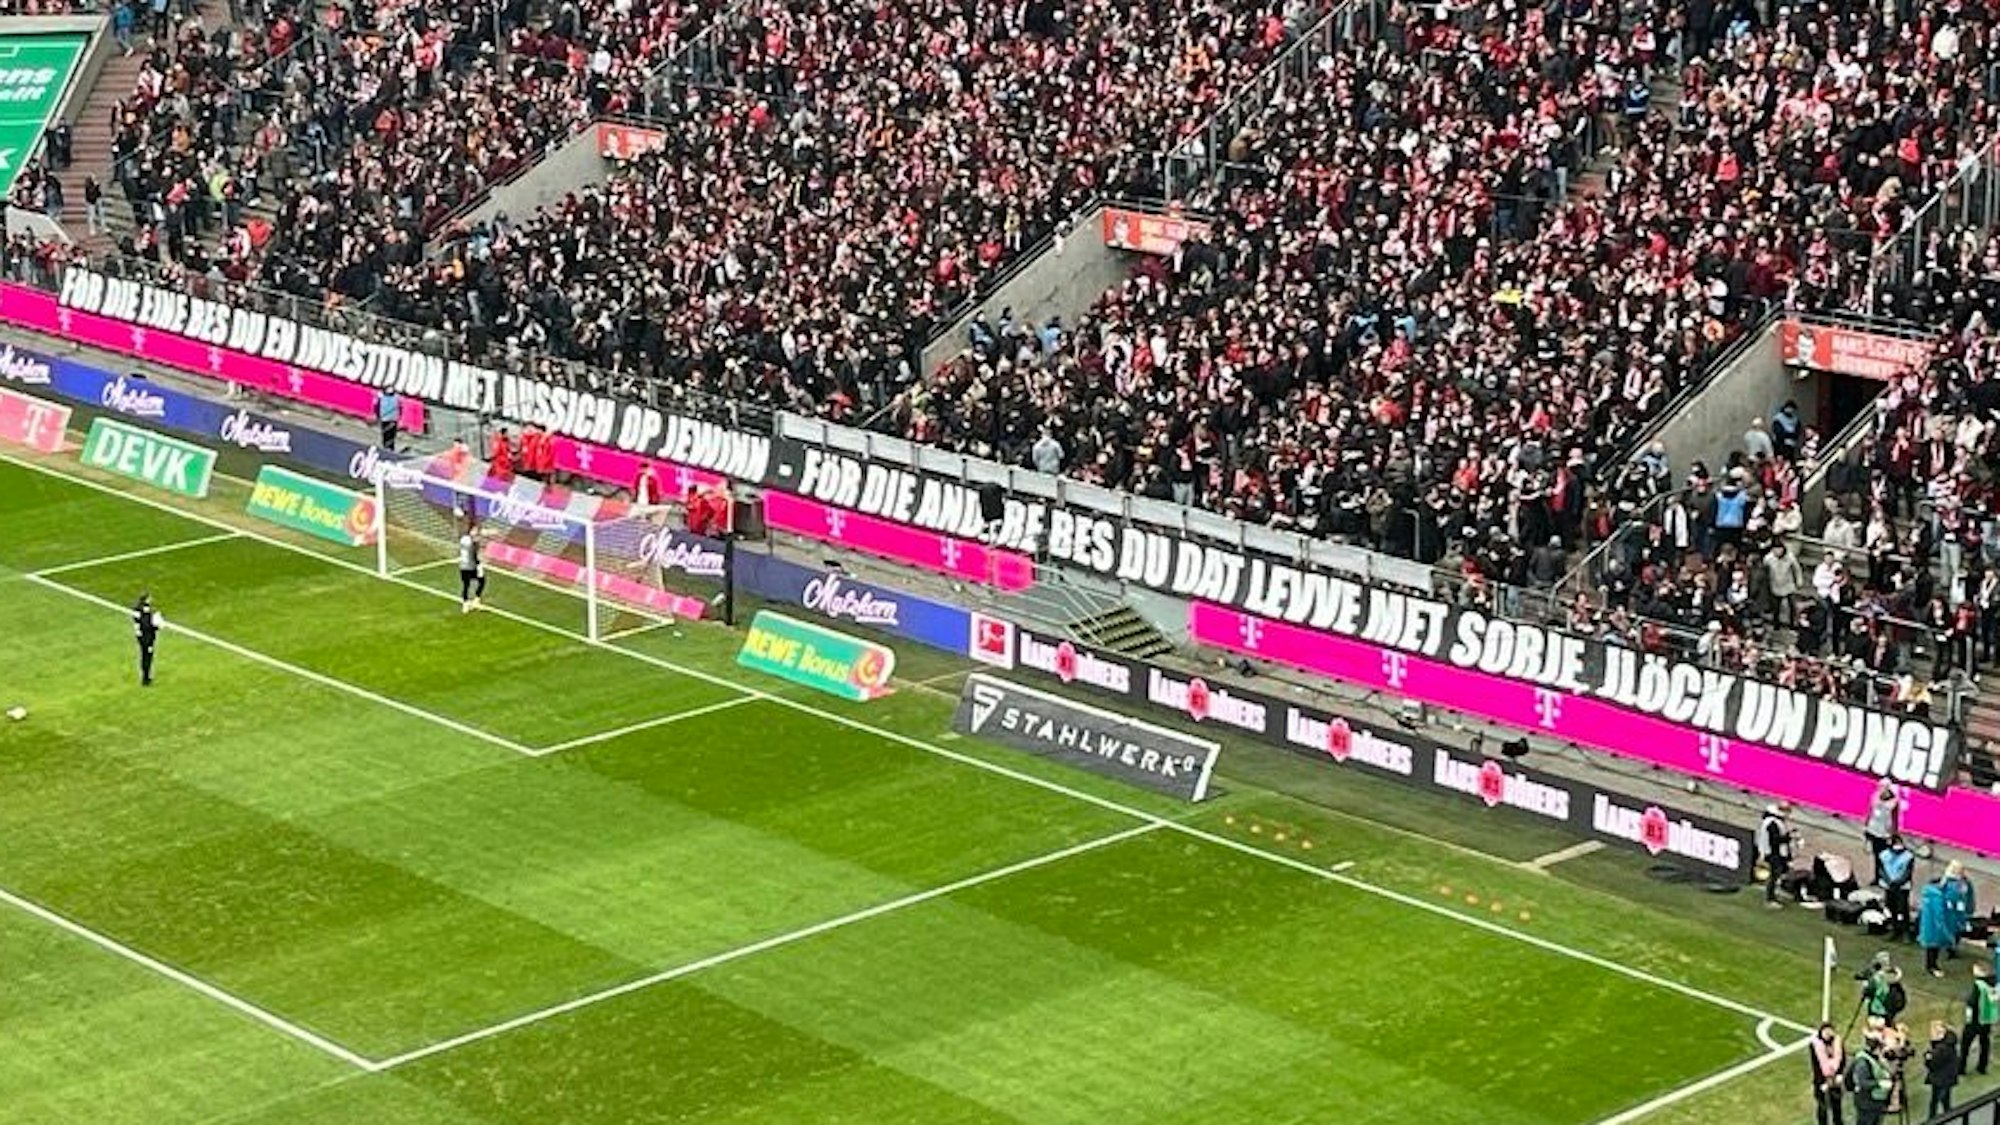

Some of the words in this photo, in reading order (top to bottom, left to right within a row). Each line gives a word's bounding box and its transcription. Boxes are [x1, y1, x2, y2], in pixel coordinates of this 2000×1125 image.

[91, 426, 196, 492] DEVK
[101, 278, 140, 320] DIE
[138, 286, 187, 332] EINE
[184, 297, 230, 345] BES
[228, 308, 266, 355] DU
[262, 316, 296, 362] EN
[295, 324, 444, 401] INVESTITION
[443, 360, 499, 414] MET
[501, 373, 616, 444] AUSSICH
[616, 404, 662, 453] OP
[656, 414, 771, 484] JEWINN
[859, 465, 917, 522] DIE
[1049, 507, 1115, 573] BES
[1118, 527, 1171, 588] DU
[1172, 539, 1245, 605] DAT
[1243, 557, 1362, 636] LEVVE
[1361, 587, 1448, 657] MET
[1595, 645, 1736, 734] JLÖCK
[1736, 676, 1807, 750] UN
[1807, 700, 1949, 790] PING!
[745, 628, 803, 668] REWE
[799, 643, 851, 682] Bonus
